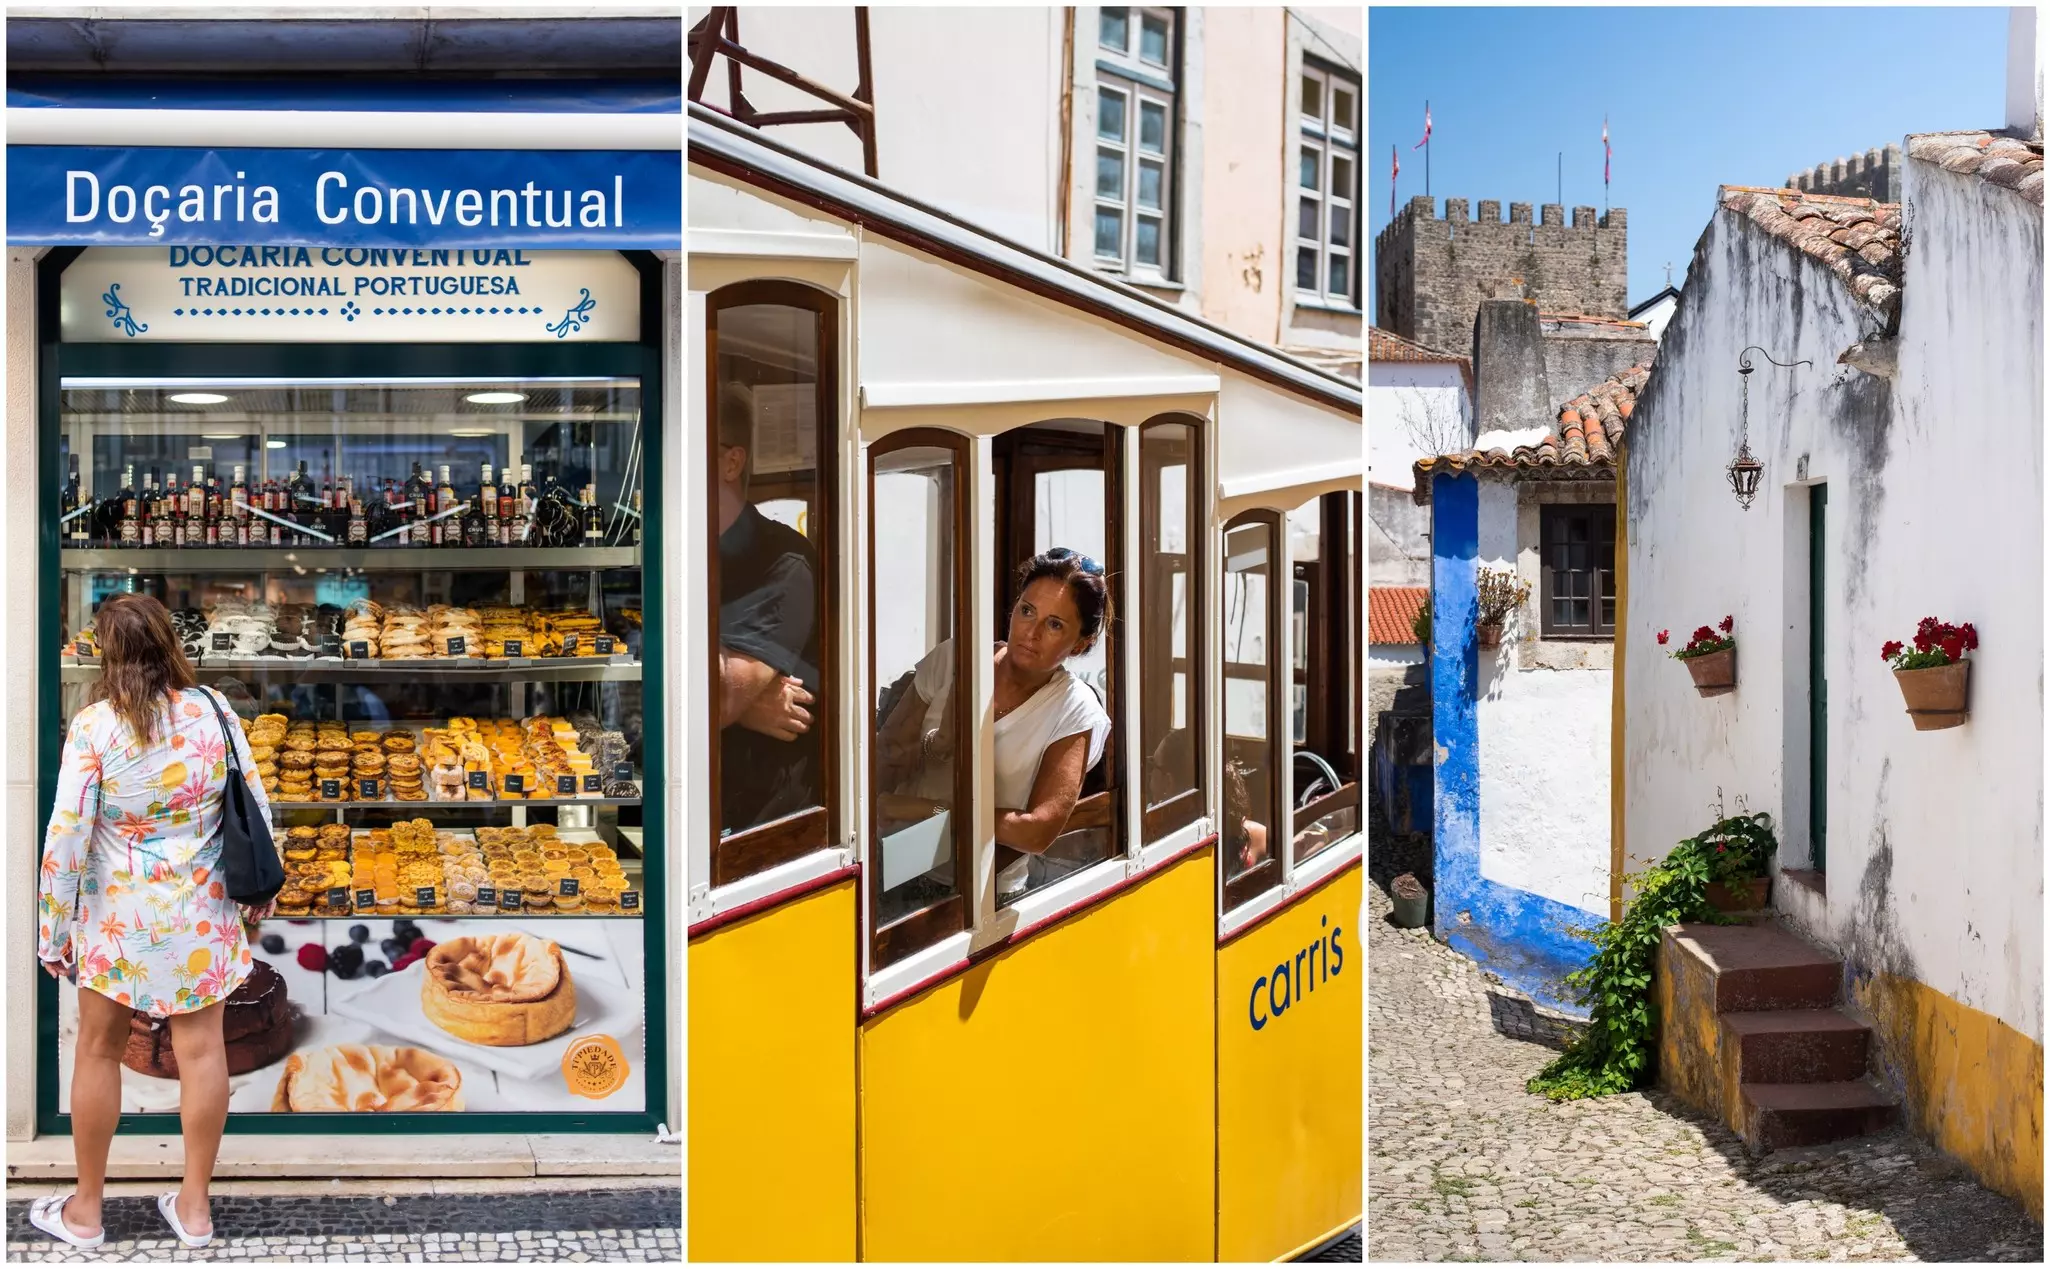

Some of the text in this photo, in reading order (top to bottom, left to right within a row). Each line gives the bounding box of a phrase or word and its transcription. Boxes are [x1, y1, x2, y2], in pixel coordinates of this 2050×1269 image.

[66, 171, 624, 236] Doçaria Conventual
[179, 275, 521, 297] TRADICIONAL PORTUGUESA
[1249, 915, 1343, 1031] carris
